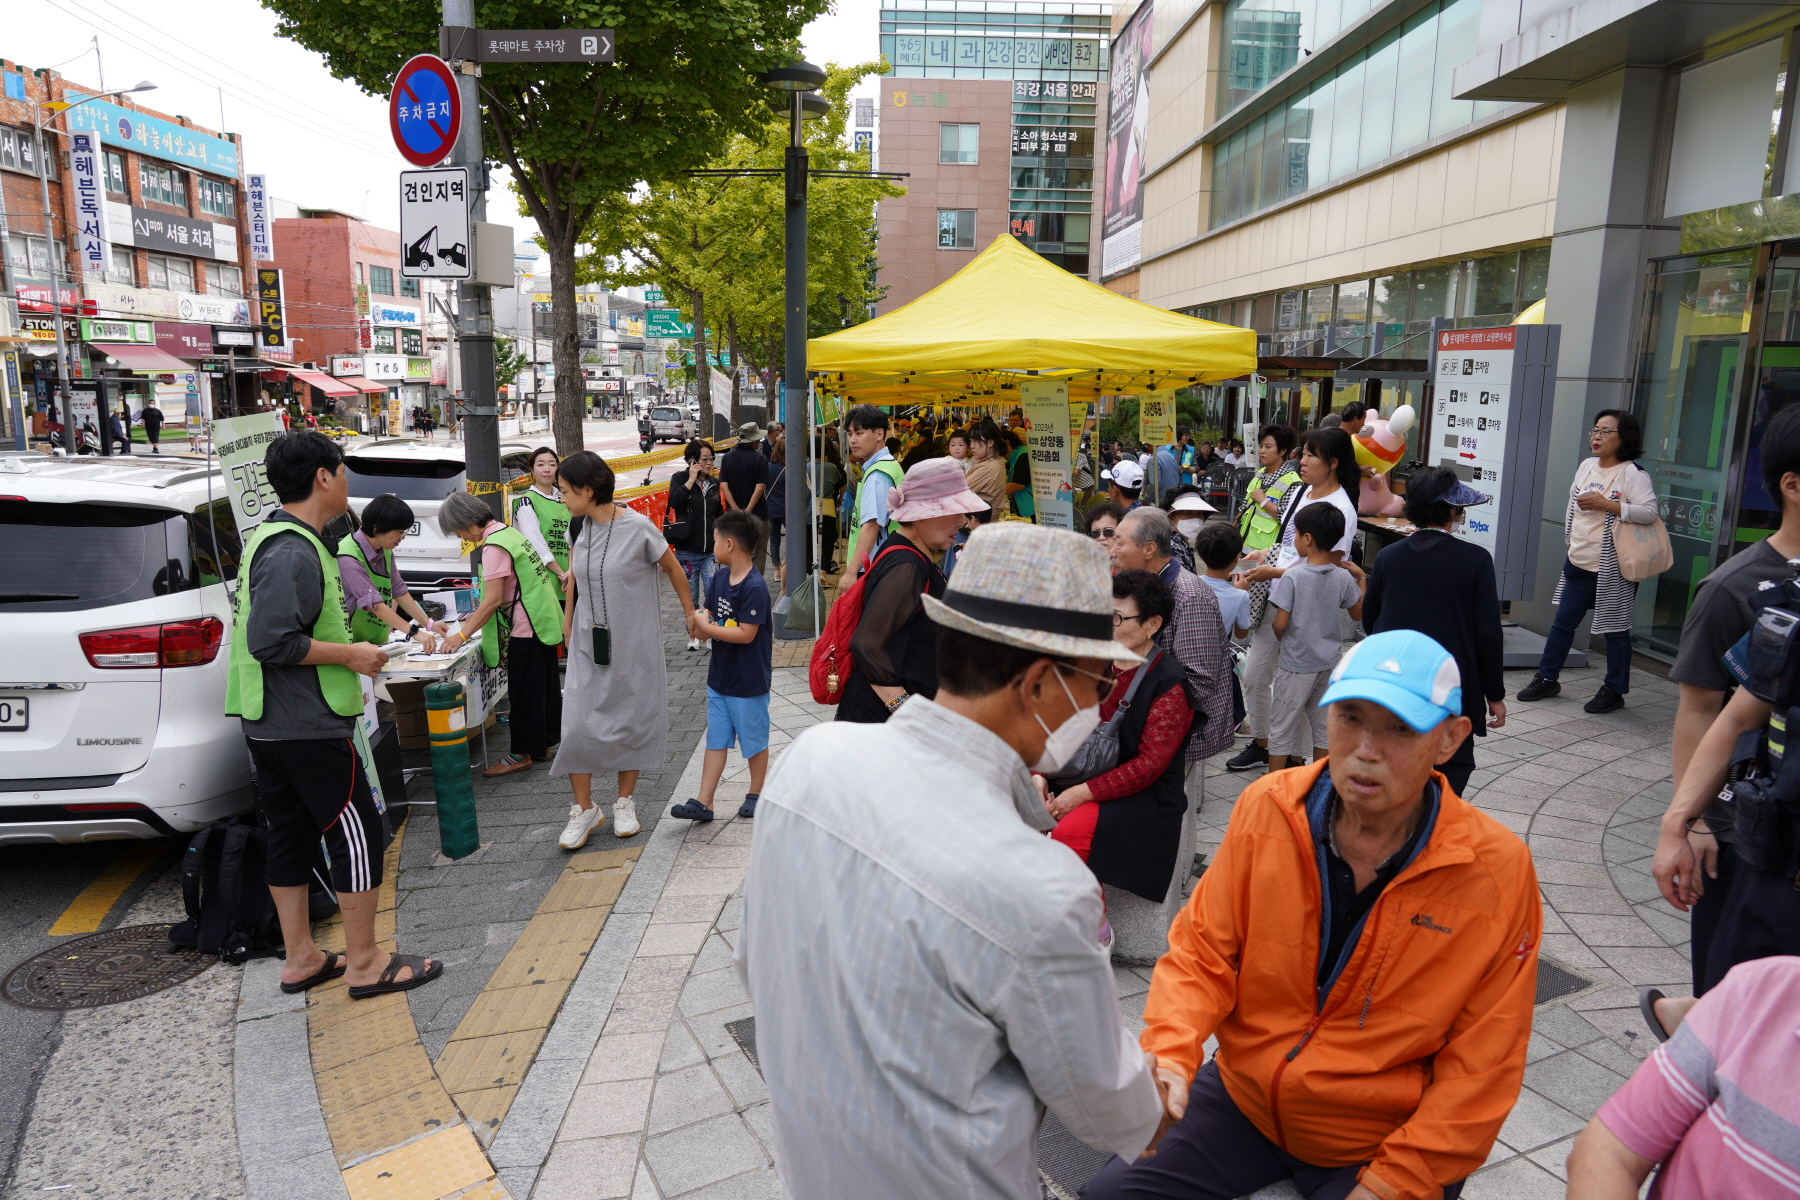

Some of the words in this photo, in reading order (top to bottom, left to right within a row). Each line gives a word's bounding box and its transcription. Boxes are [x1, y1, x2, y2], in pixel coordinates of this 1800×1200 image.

[489, 40, 530, 52] 롯데마트
[534, 39, 566, 52] 주차장
[899, 38, 922, 51] 365
[899, 53, 921, 63] 메디
[1015, 81, 1041, 97] 최강
[1043, 82, 1068, 98] 서울
[1071, 83, 1097, 98] 안과
[911, 92, 946, 107] 농협
[399, 100, 450, 122] 주차금지
[856, 106, 873, 116] 정형
[856, 116, 872, 126] 외과
[136, 122, 207, 164] 하늘씨앗교회
[405, 180, 464, 203] 견인지역
[74, 156, 104, 260] 헤븐독서실
[251, 190, 265, 244] 헤븐스터디
[939, 213, 955, 221] 연세
[149, 220, 164, 234] 미아
[166, 224, 188, 245] 서울
[191, 228, 213, 249] 치과
[940, 221, 954, 246] 치과
[1011, 219, 1034, 237] 연세
[253, 245, 269, 254] 카페
[19, 289, 71, 306] 비행기차
[263, 289, 278, 298] 스톤
[199, 305, 206, 313] W
[207, 306, 222, 315] BIKE
[262, 302, 281, 330] PC
[26, 320, 57, 330] STON
[63, 321, 77, 330] PC
[1450, 334, 1470, 344] 롯데마트
[1471, 333, 1483, 343] 삼양점
[1474, 361, 1490, 374] 주차장
[1459, 391, 1468, 402] 병원
[1490, 393, 1500, 404] 약국
[1034, 423, 1054, 434] 2023년
[1487, 418, 1502, 431] 주차장
[1039, 435, 1064, 448] 삼양동
[1461, 436, 1478, 449] 화장실
[1031, 450, 1060, 463] 주민총회
[1483, 470, 1498, 482] 안경점
[1469, 519, 1490, 533] toybox
